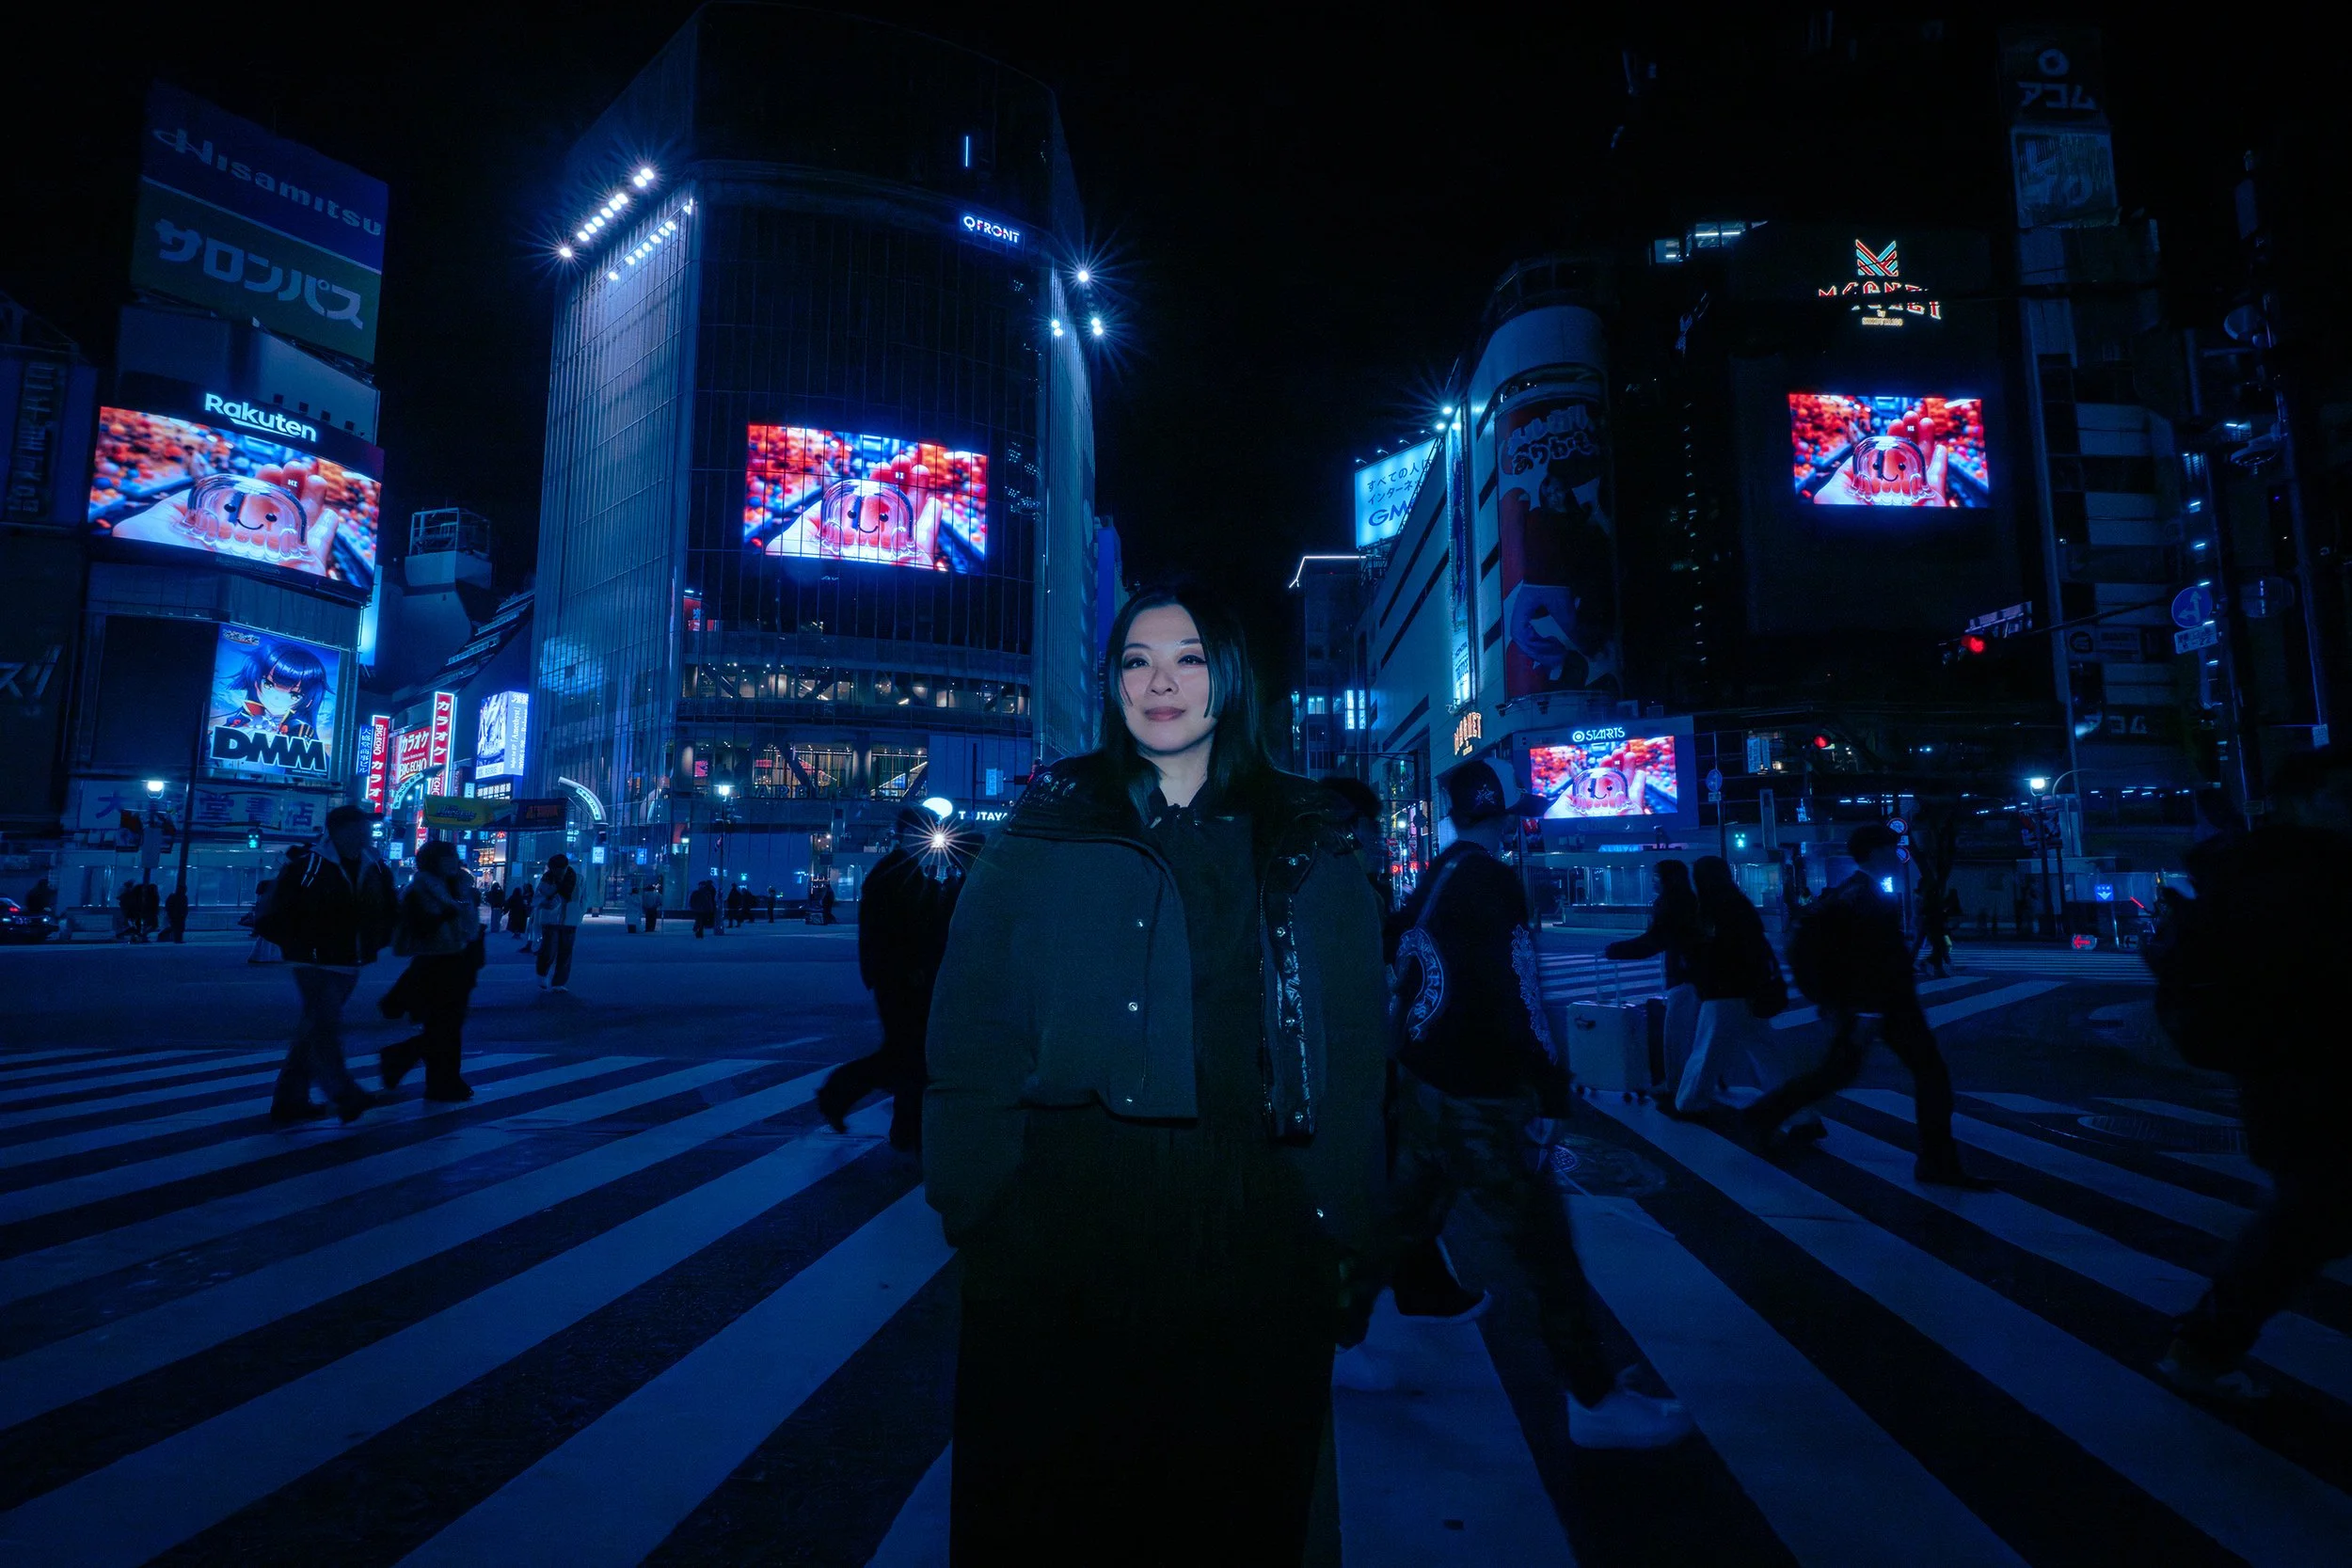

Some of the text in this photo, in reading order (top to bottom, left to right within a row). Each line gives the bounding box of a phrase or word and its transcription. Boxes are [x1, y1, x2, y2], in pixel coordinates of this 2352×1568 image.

[152, 128, 382, 236] Hisamitsu
[154, 218, 364, 331] サロンパス
[204, 392, 317, 443] Rakuten
[211, 725, 327, 772] DMM
[400, 729, 430, 753] カラオケ
[433, 701, 450, 757] カラオケ
